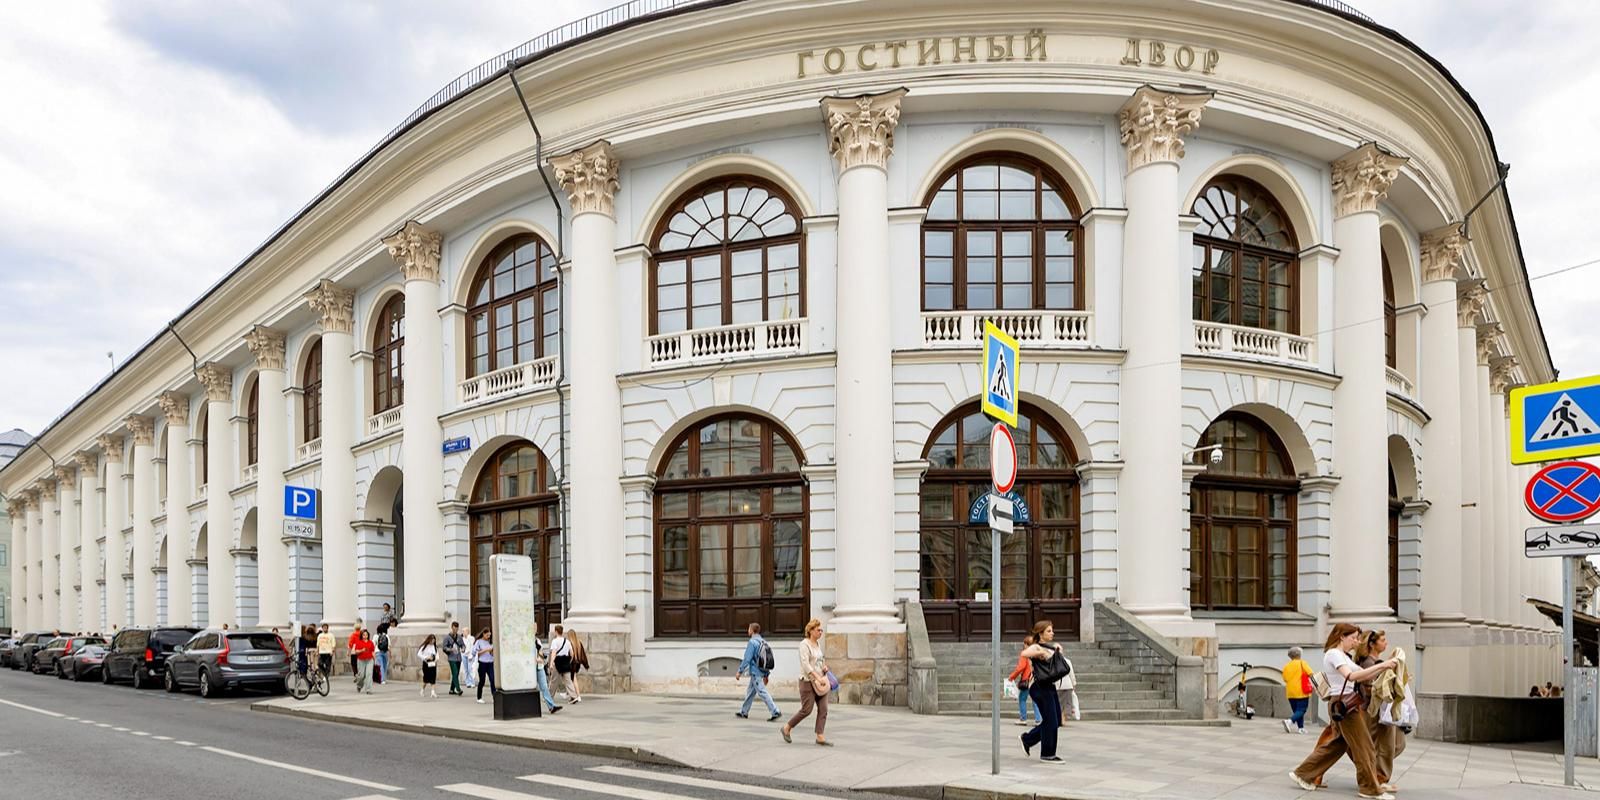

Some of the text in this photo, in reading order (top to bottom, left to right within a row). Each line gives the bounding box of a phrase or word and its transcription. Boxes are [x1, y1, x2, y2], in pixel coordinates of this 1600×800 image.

[797, 28, 1220, 78] ГОСТИНЫЙ ДВОР
[293, 489, 311, 515] P
[302, 526, 313, 534] 20
